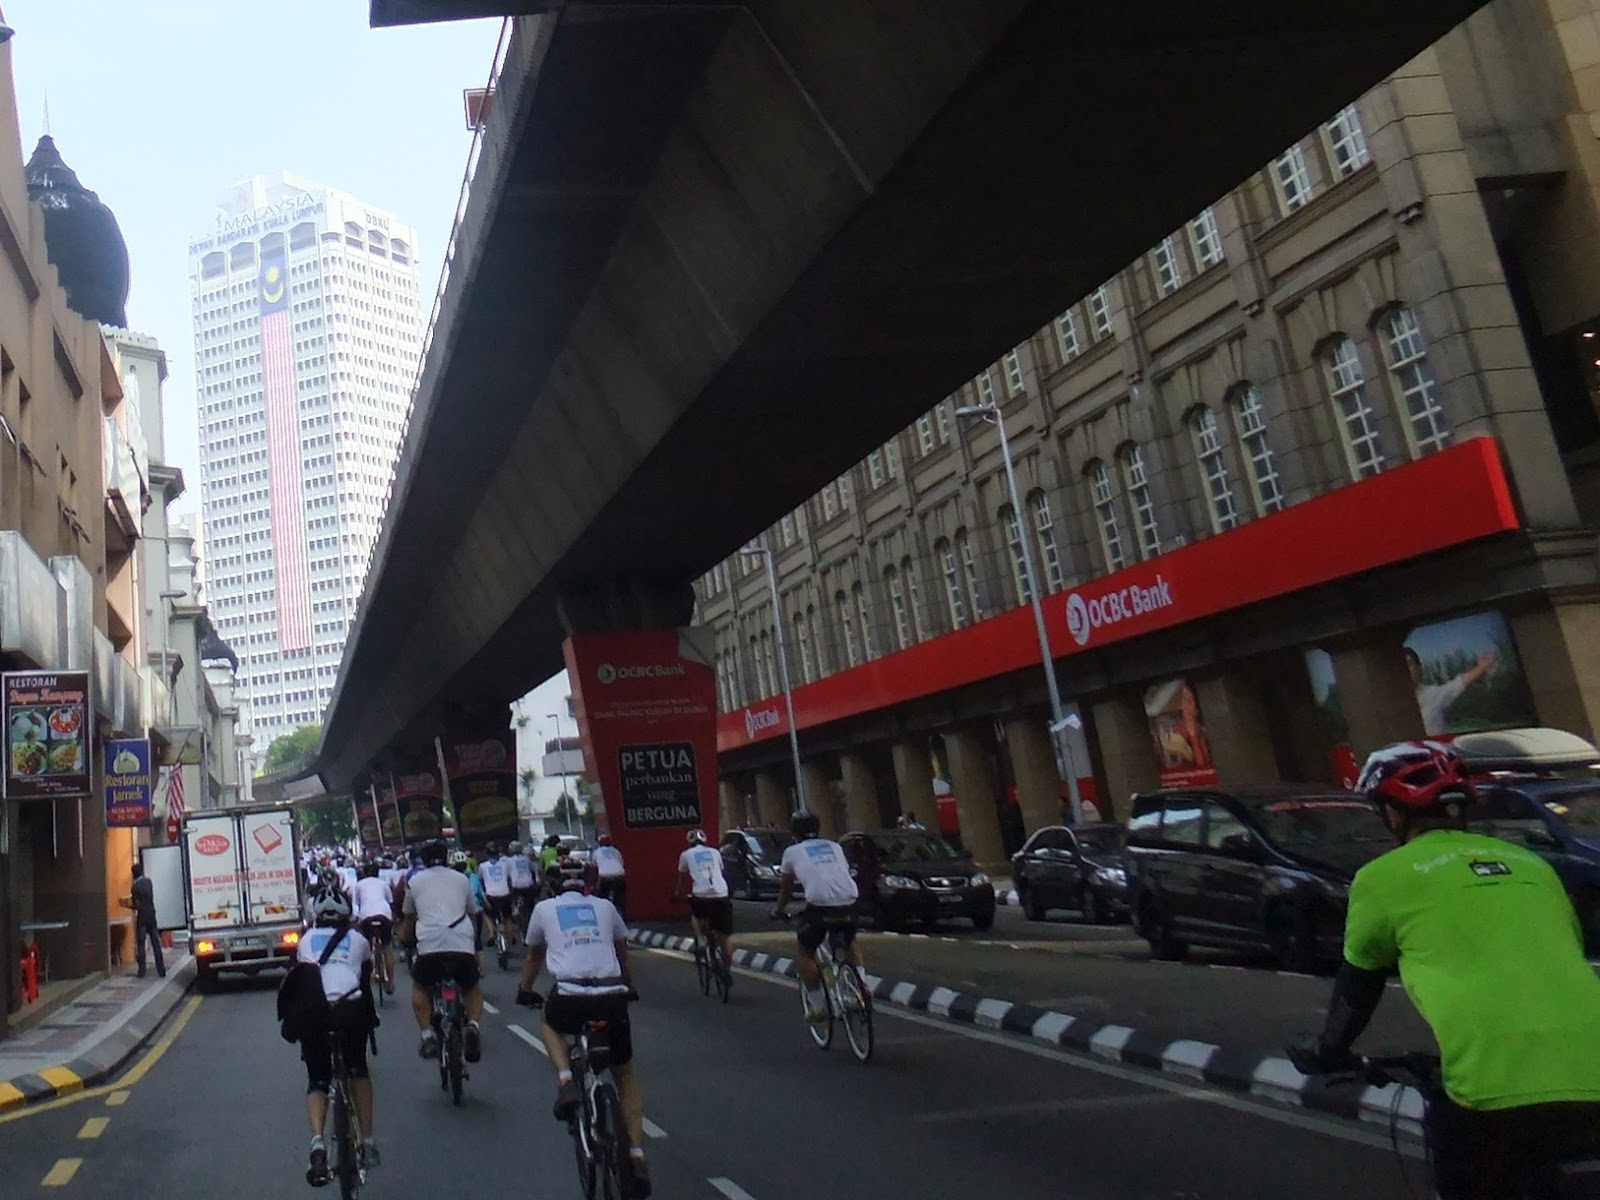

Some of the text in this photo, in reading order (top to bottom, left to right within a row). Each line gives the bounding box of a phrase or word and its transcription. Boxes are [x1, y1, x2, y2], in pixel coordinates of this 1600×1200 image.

[1088, 574, 1173, 628] OCBC Bank
[618, 663, 686, 678] OCBC Bank
[9, 677, 58, 688] RESTORAN
[621, 749, 692, 771] PETUA
[105, 774, 150, 786] Restoran
[625, 770, 693, 791] perbankan
[626, 804, 698, 822] BERGUNA
